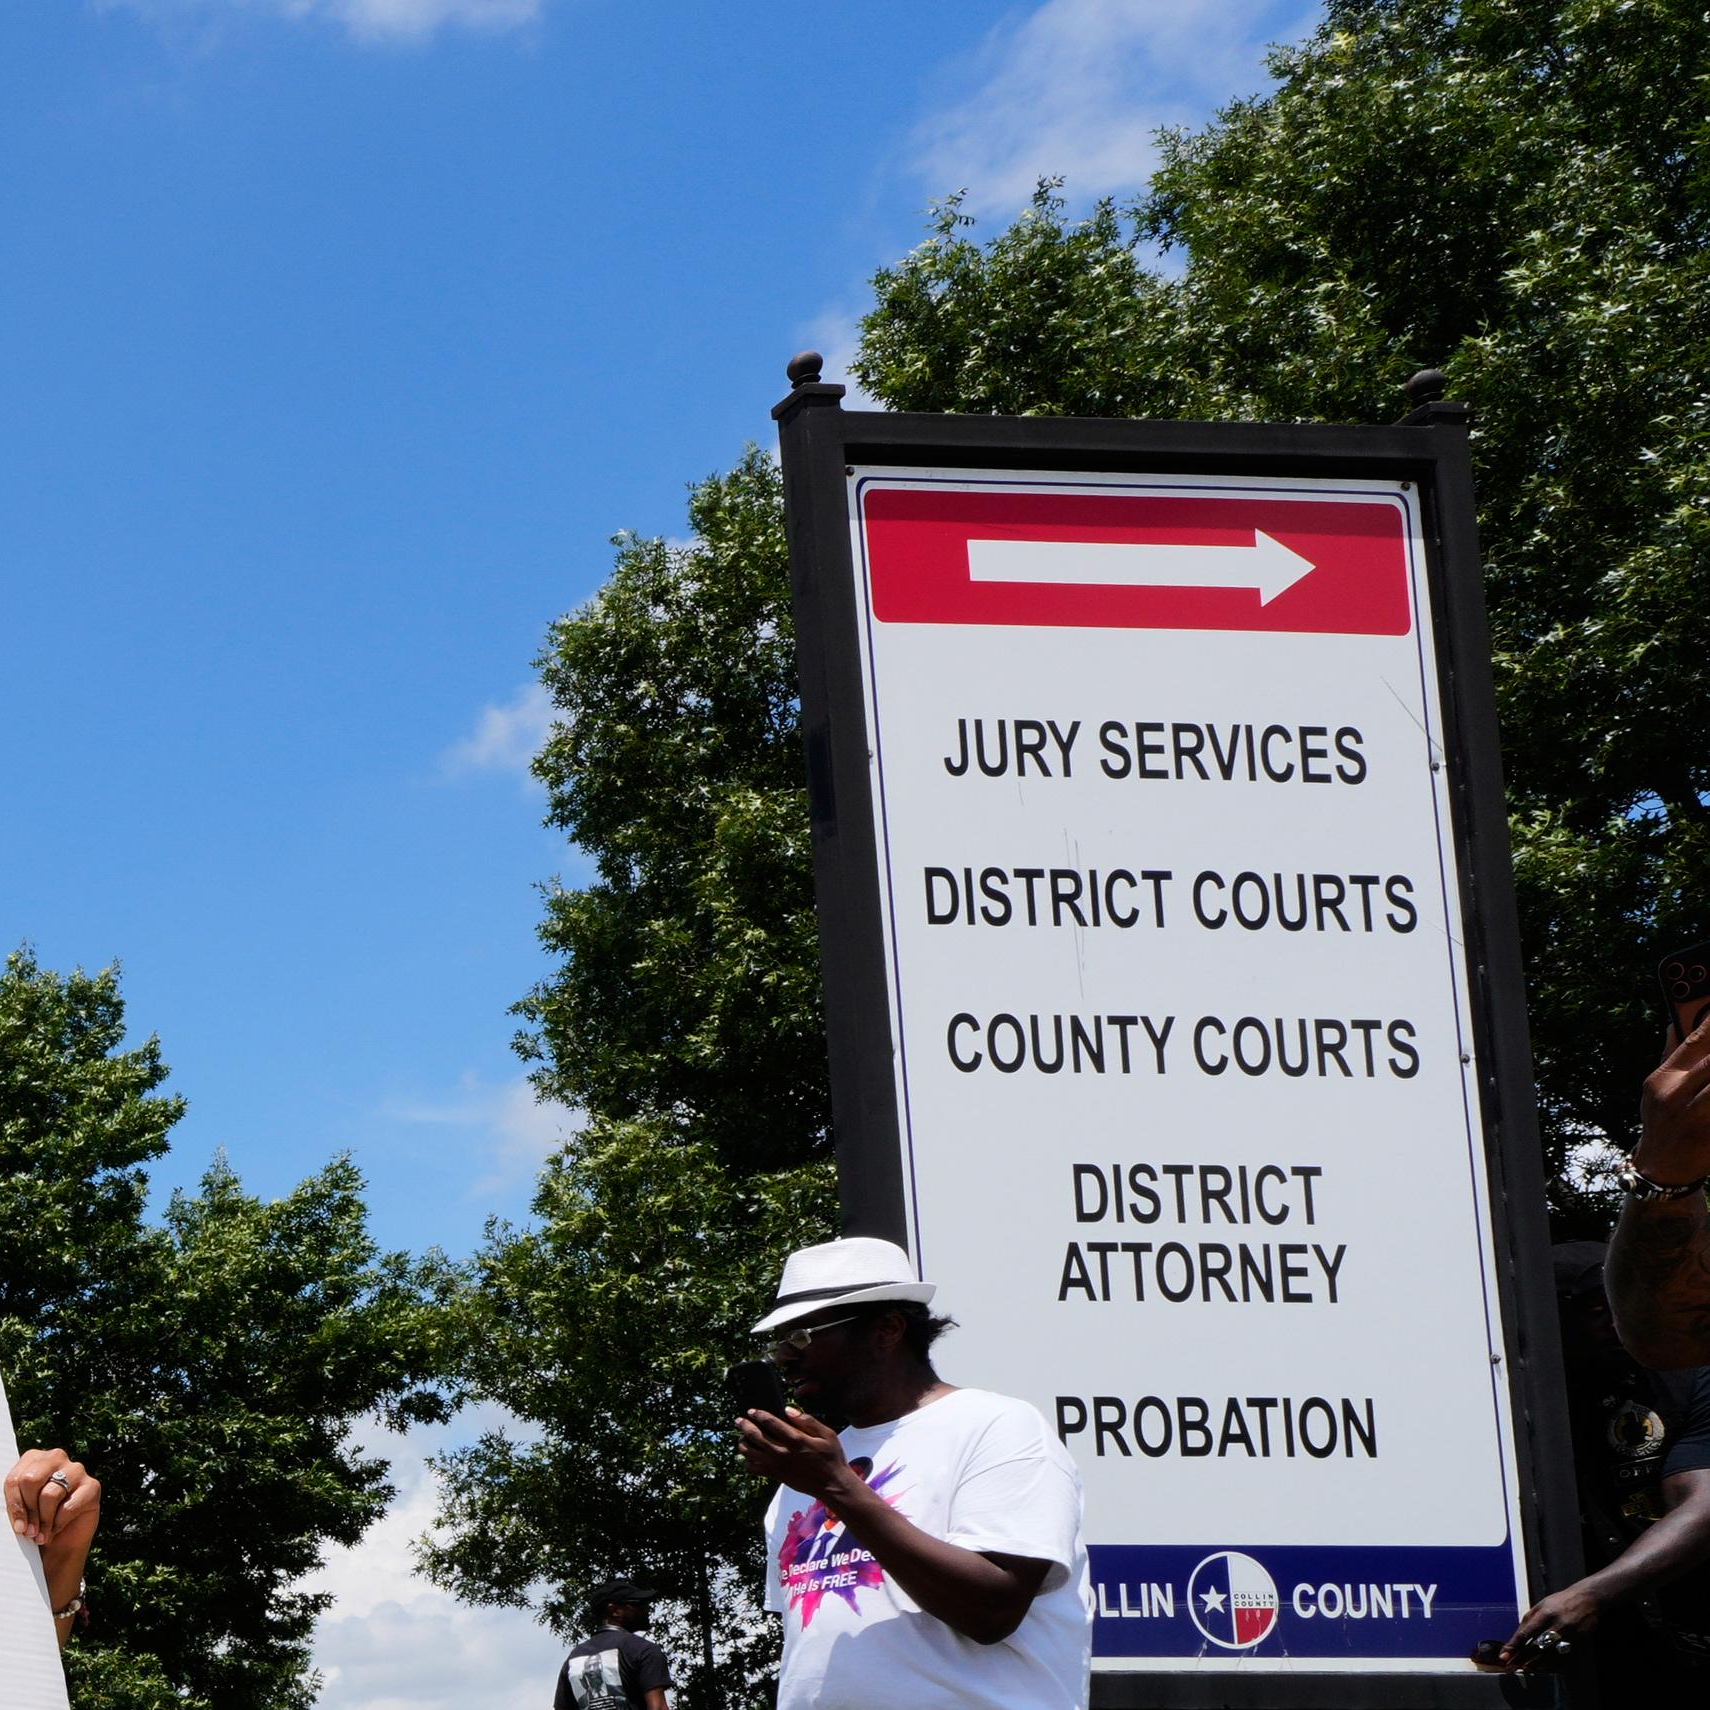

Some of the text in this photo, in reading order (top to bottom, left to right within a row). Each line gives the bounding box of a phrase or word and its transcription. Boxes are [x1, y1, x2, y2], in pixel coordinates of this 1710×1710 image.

[944, 719, 1366, 784] JURY SERVICES
[925, 867, 1417, 933] DISTRICT COURTS
[948, 1013, 1419, 1078] COUNTY COURTS
[1073, 1164, 1321, 1225] DISTRICT
[1059, 1242, 1346, 1303] ATTORNEY
[1055, 1396, 1377, 1458] PROBATION
[808, 1578, 820, 1592] Is
[821, 1570, 858, 1590] FREE
[831, 1552, 850, 1568] We
[1291, 1582, 1438, 1620] COUNTY
